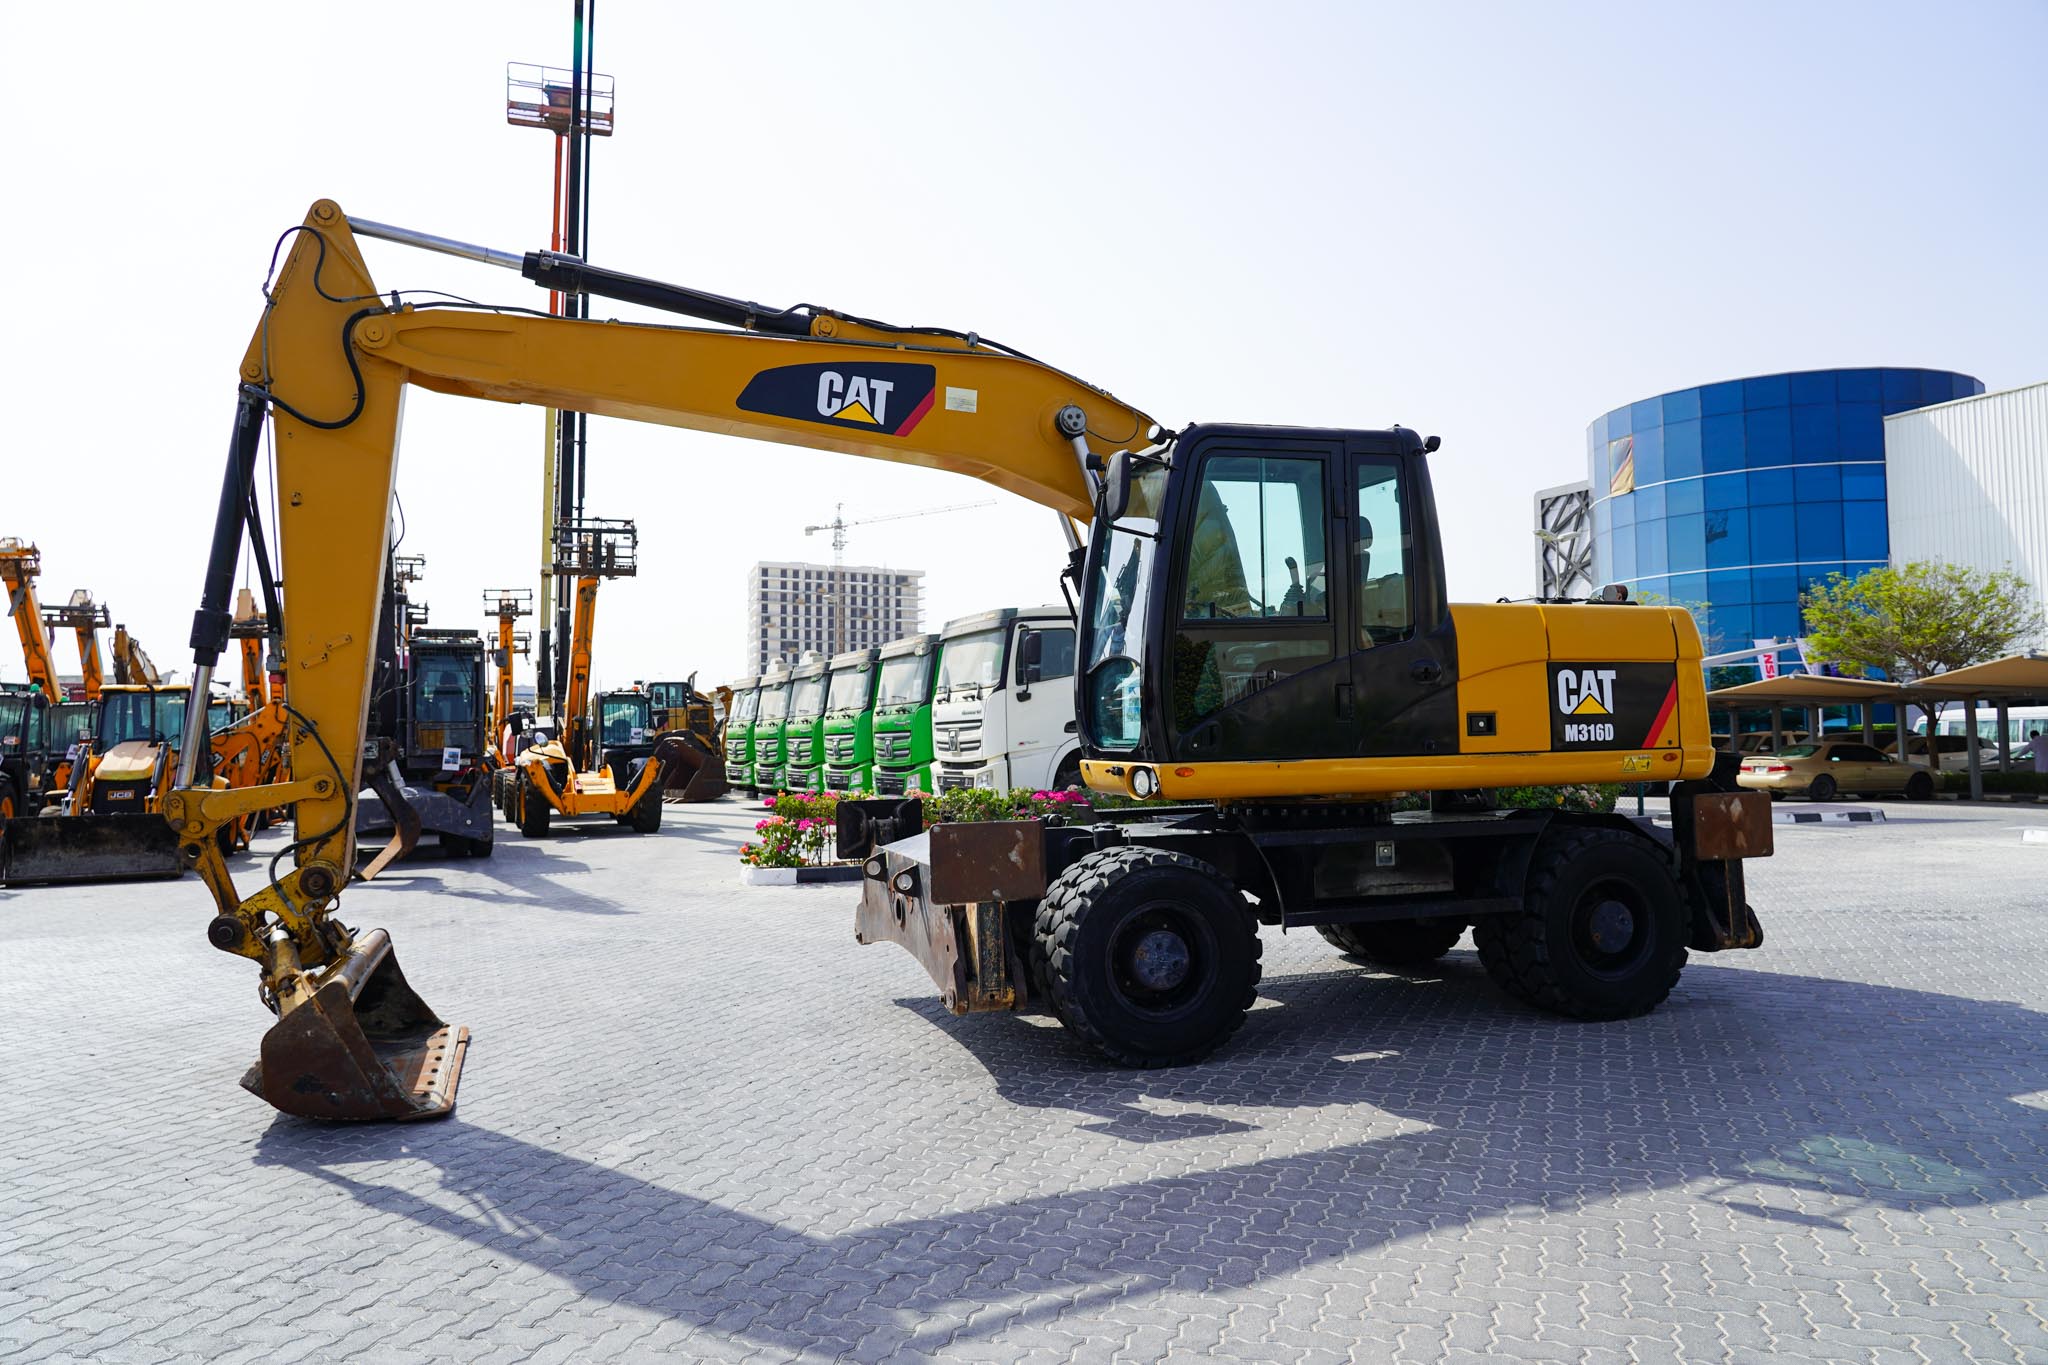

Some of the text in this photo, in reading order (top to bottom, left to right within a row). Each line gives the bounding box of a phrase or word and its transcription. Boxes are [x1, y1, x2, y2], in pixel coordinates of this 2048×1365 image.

[817, 371, 894, 425] CAT
[1557, 669, 1616, 715] CAT
[1564, 723, 1614, 742] M316D
[110, 791, 132, 799] JCB
